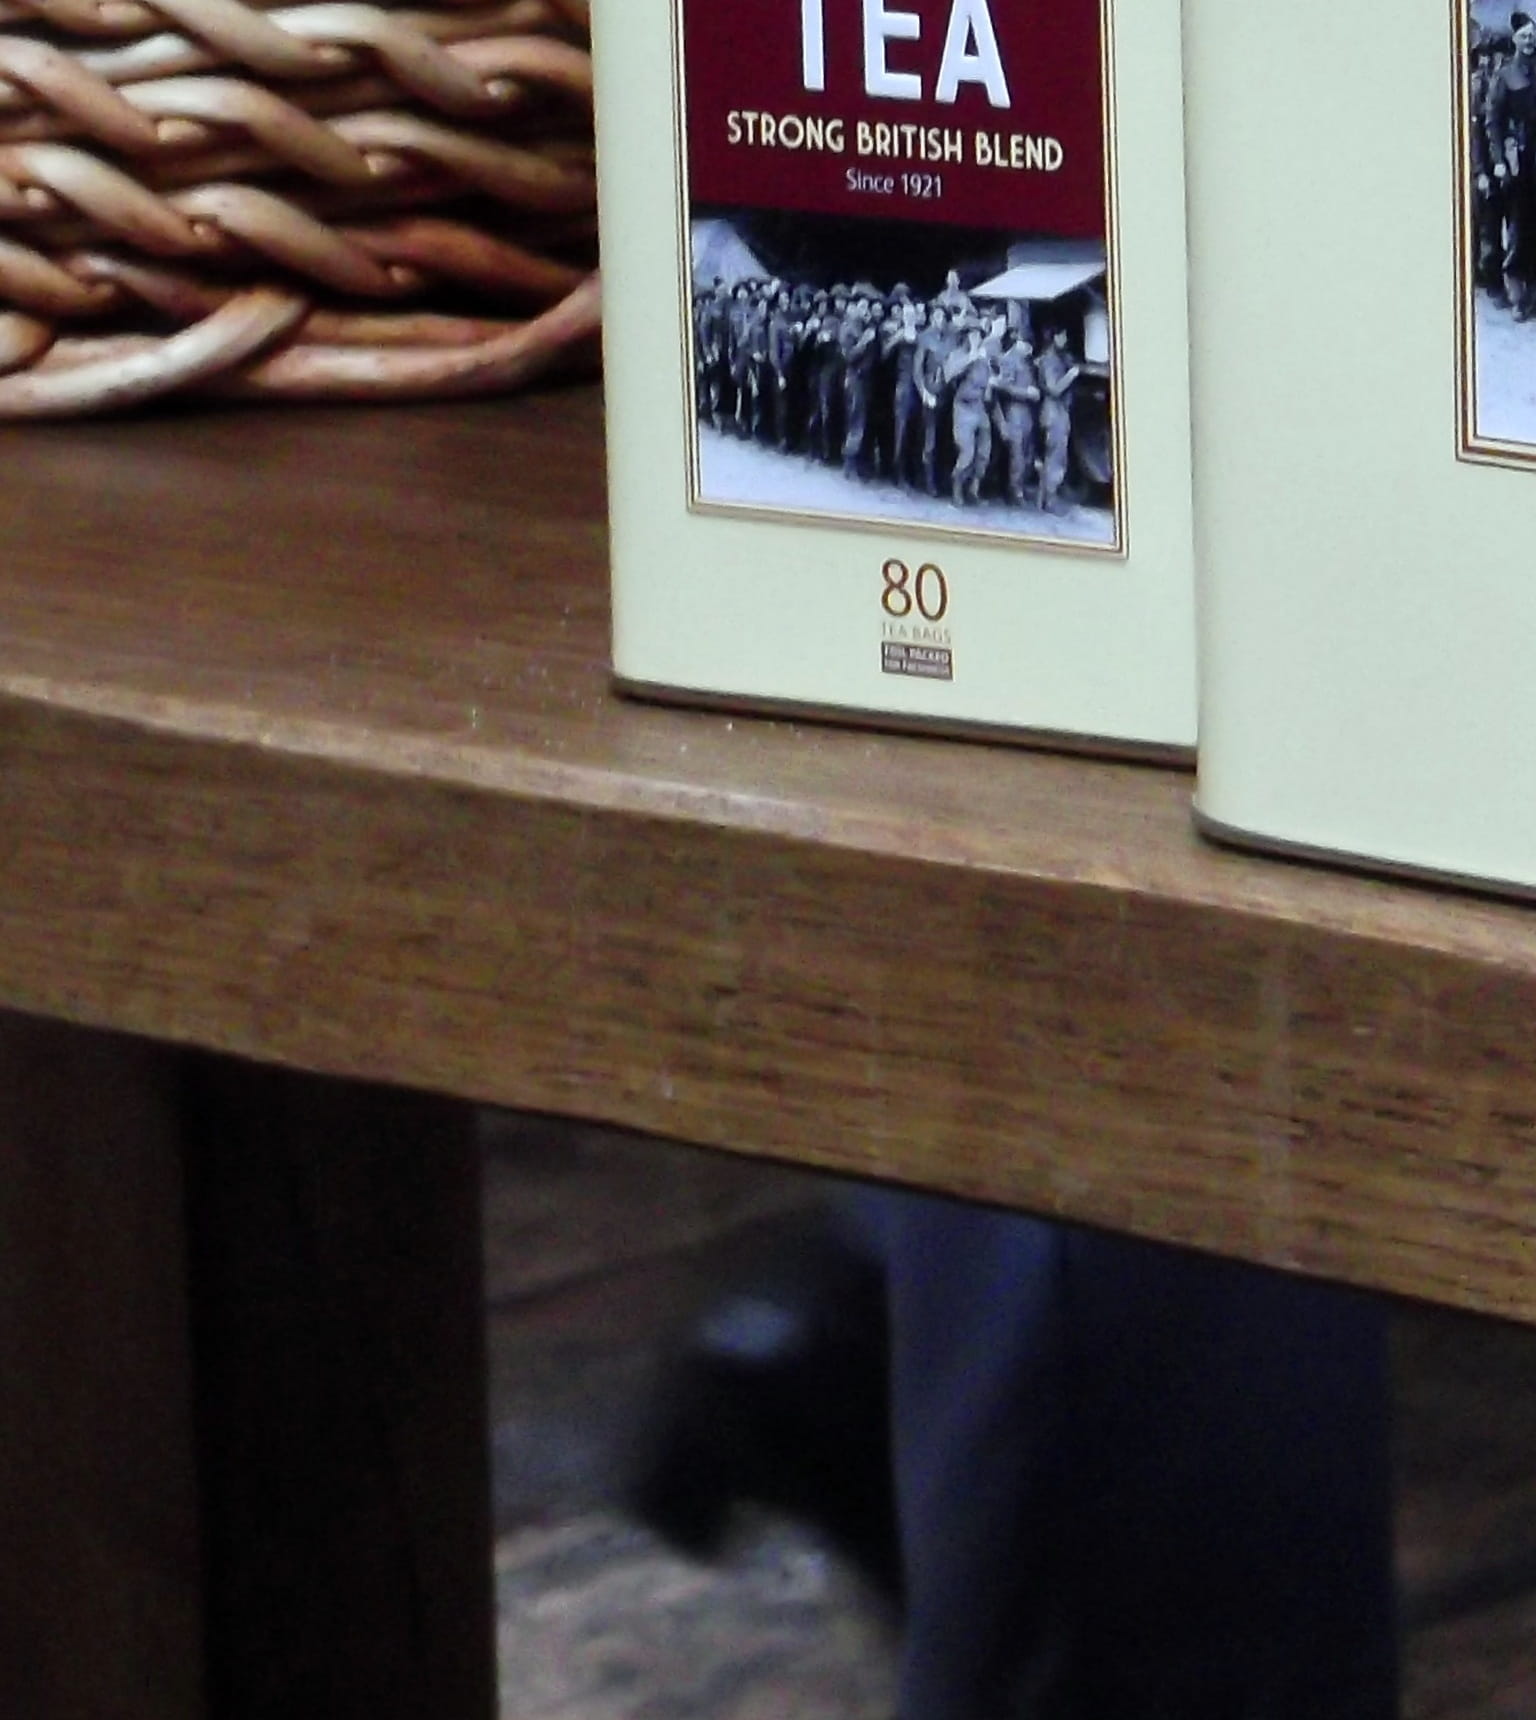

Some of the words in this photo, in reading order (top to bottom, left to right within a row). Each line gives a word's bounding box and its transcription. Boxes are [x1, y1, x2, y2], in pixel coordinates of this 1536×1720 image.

[727, 110, 845, 155] STRONG
[856, 121, 963, 165] BRITISH
[974, 131, 1064, 172] BLEND
[845, 166, 895, 195] Since
[901, 172, 943, 198] 1921
[881, 558, 948, 623] 80
